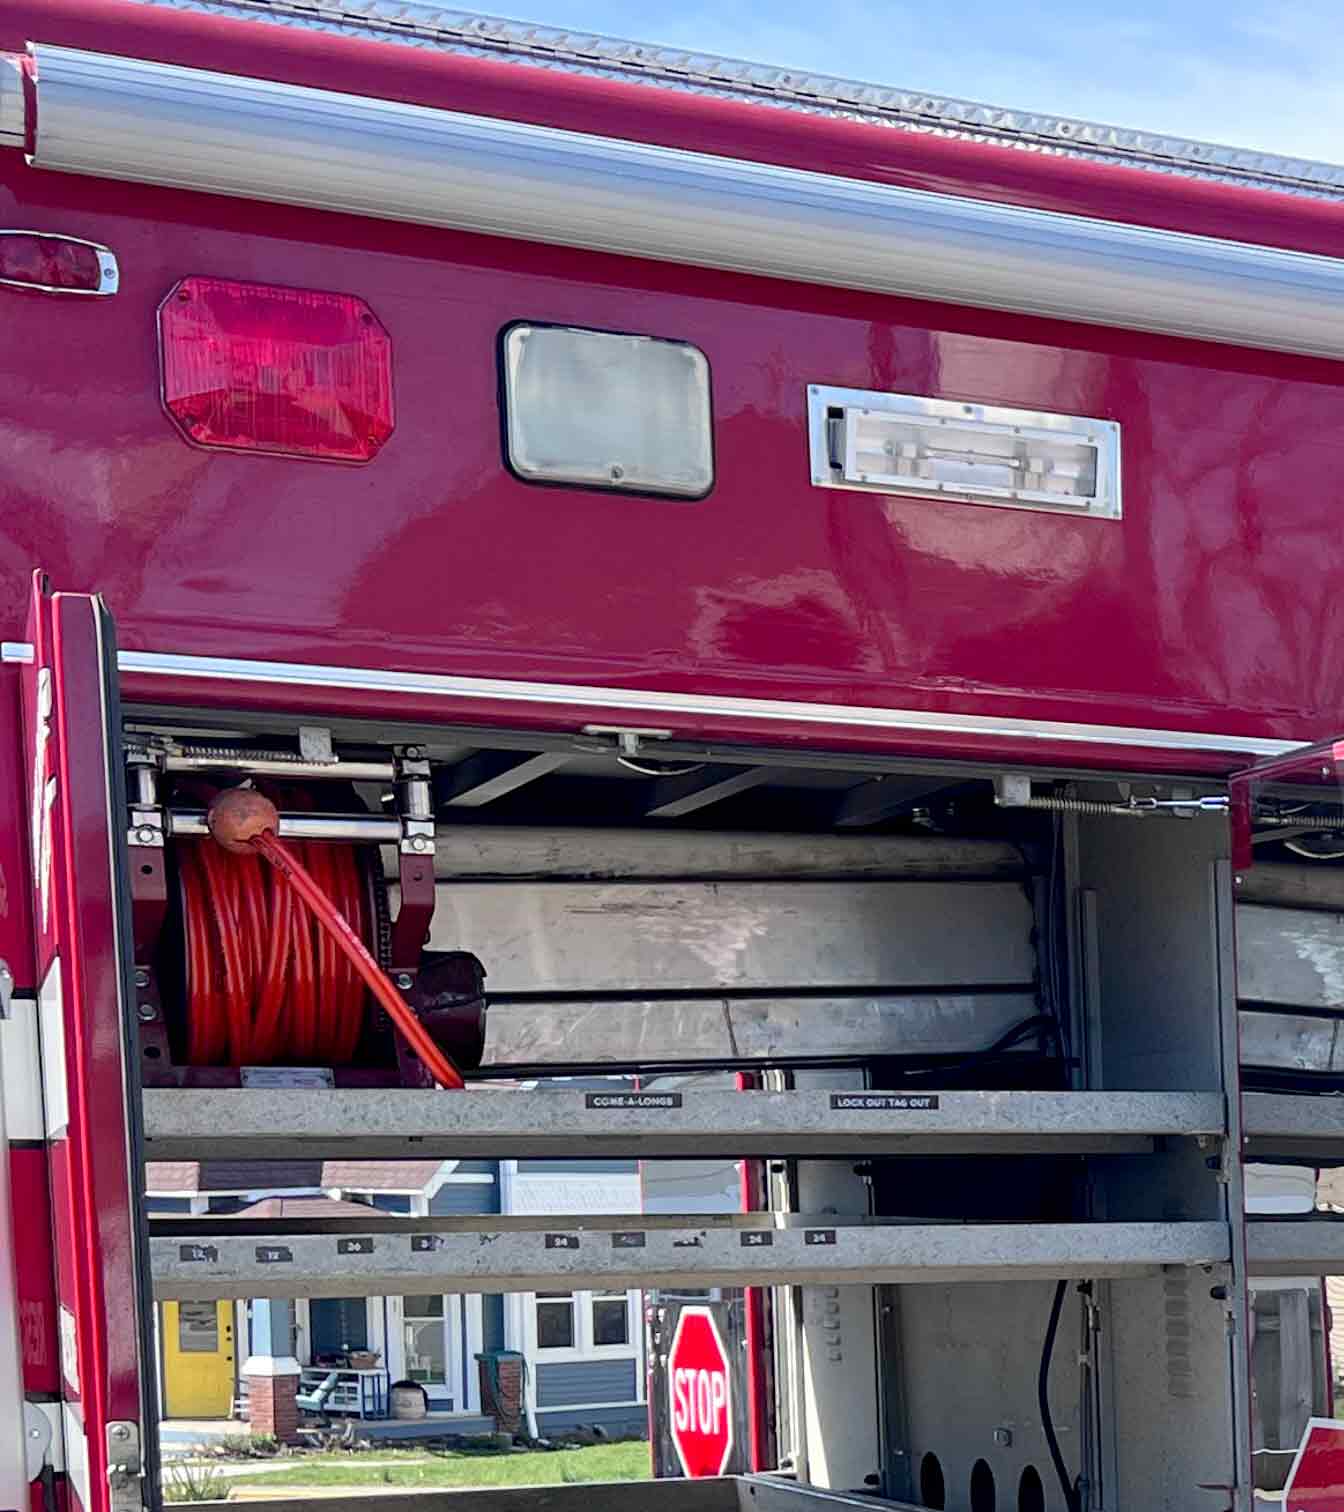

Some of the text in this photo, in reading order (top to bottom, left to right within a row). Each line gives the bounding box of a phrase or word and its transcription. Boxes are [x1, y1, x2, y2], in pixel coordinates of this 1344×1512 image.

[837, 1097, 930, 1107] LOCK OUT TAG OUT
[674, 1367, 726, 1435] STOP
